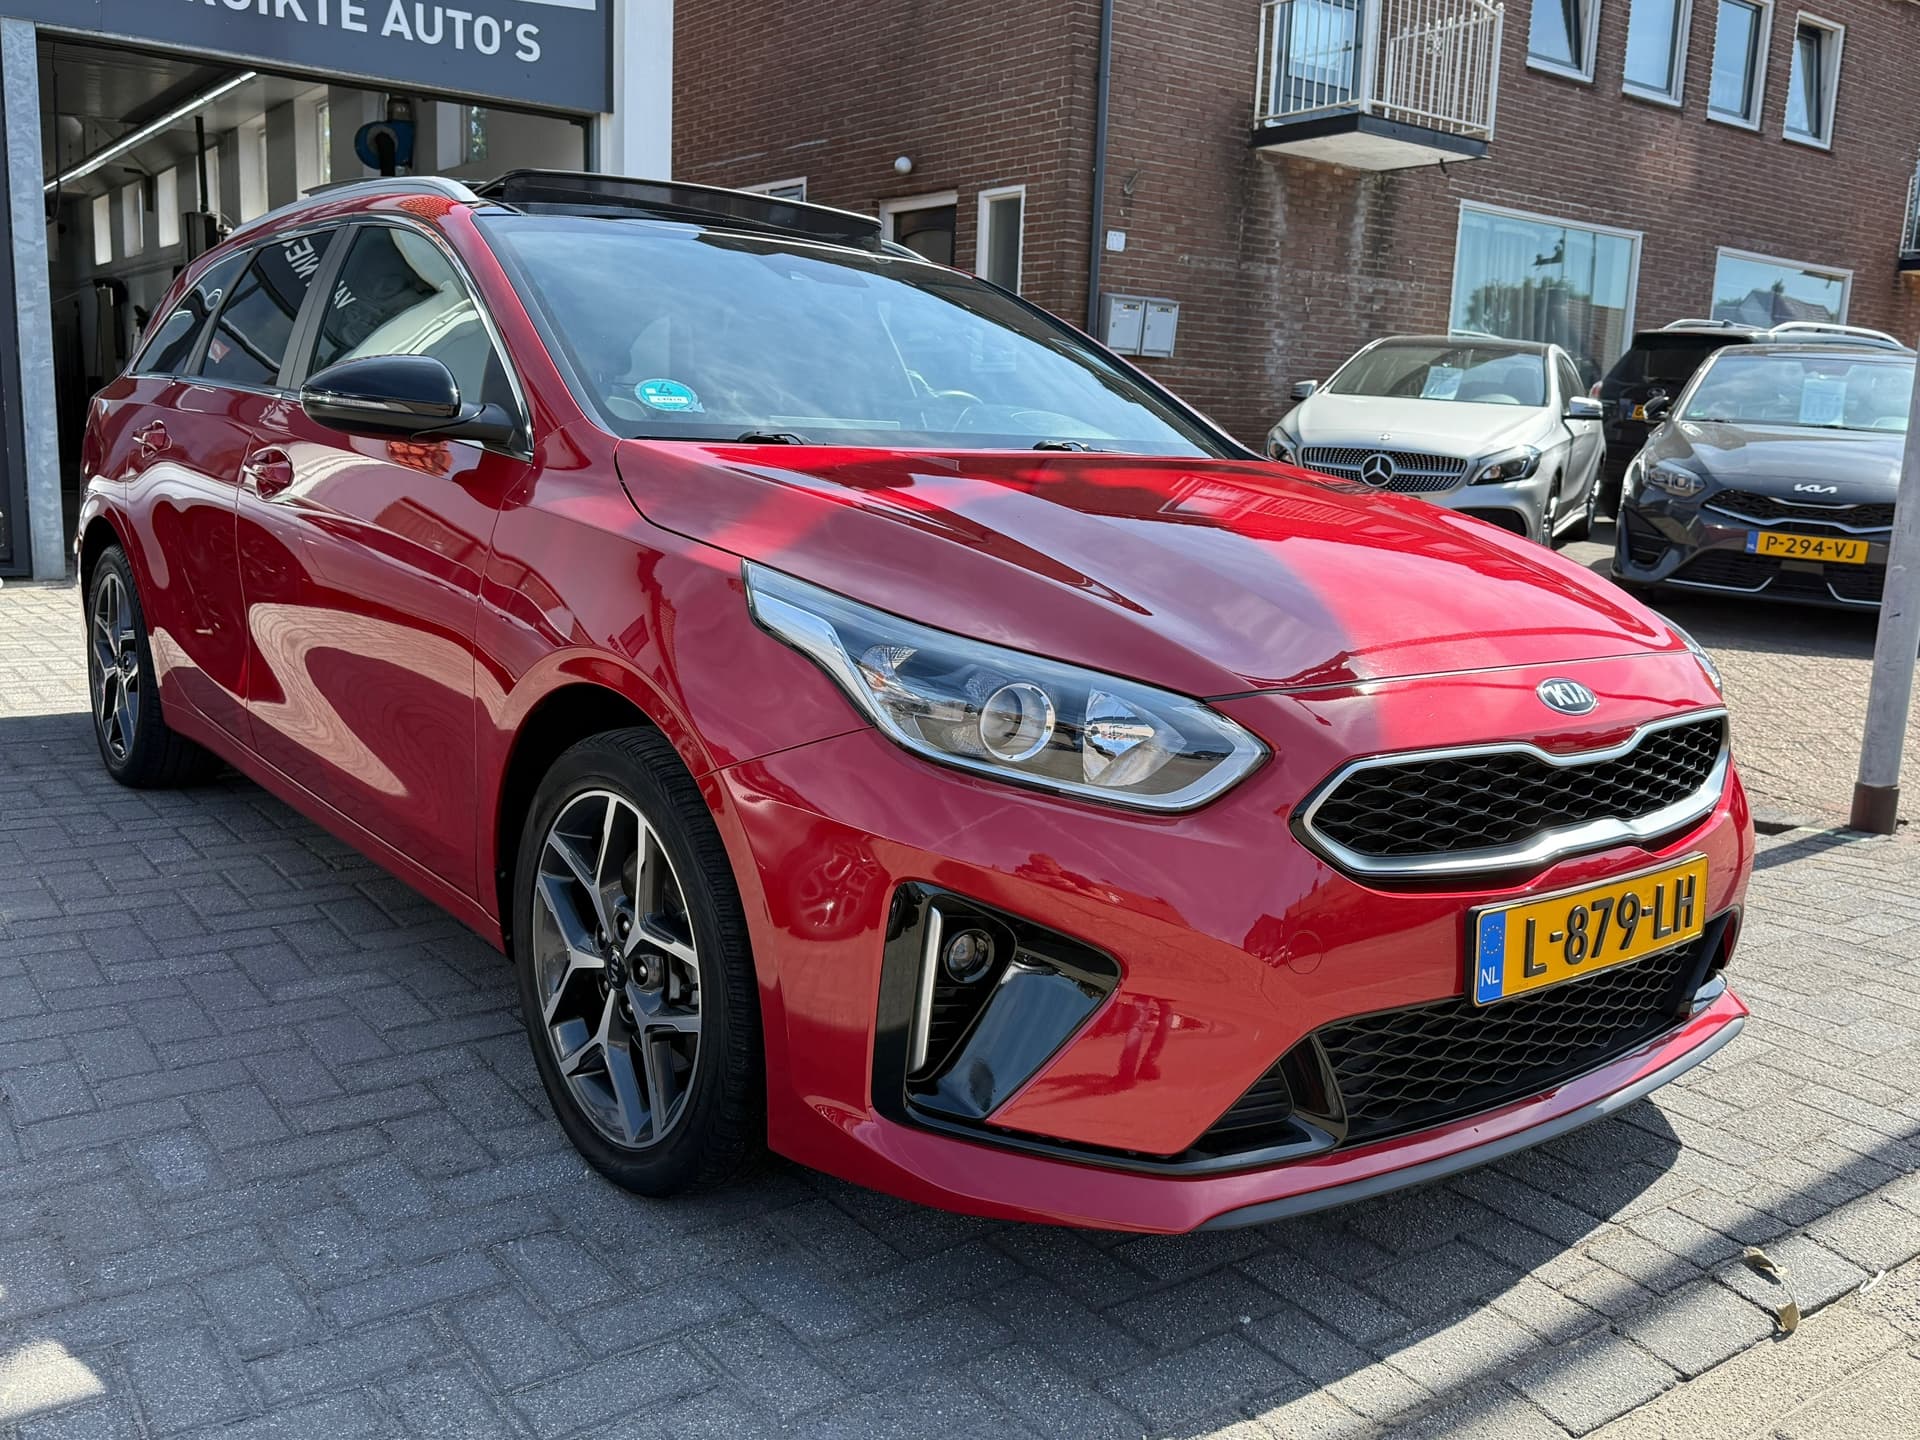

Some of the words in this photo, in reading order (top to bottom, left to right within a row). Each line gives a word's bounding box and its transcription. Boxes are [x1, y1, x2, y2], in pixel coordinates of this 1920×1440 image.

[381, 0, 541, 62] AUTO'S
[1765, 535, 1858, 560] P-294-VJ
[1543, 682, 1593, 706] KIA
[1481, 966, 1500, 987] NL
[1523, 873, 1697, 979] L-879-LH
